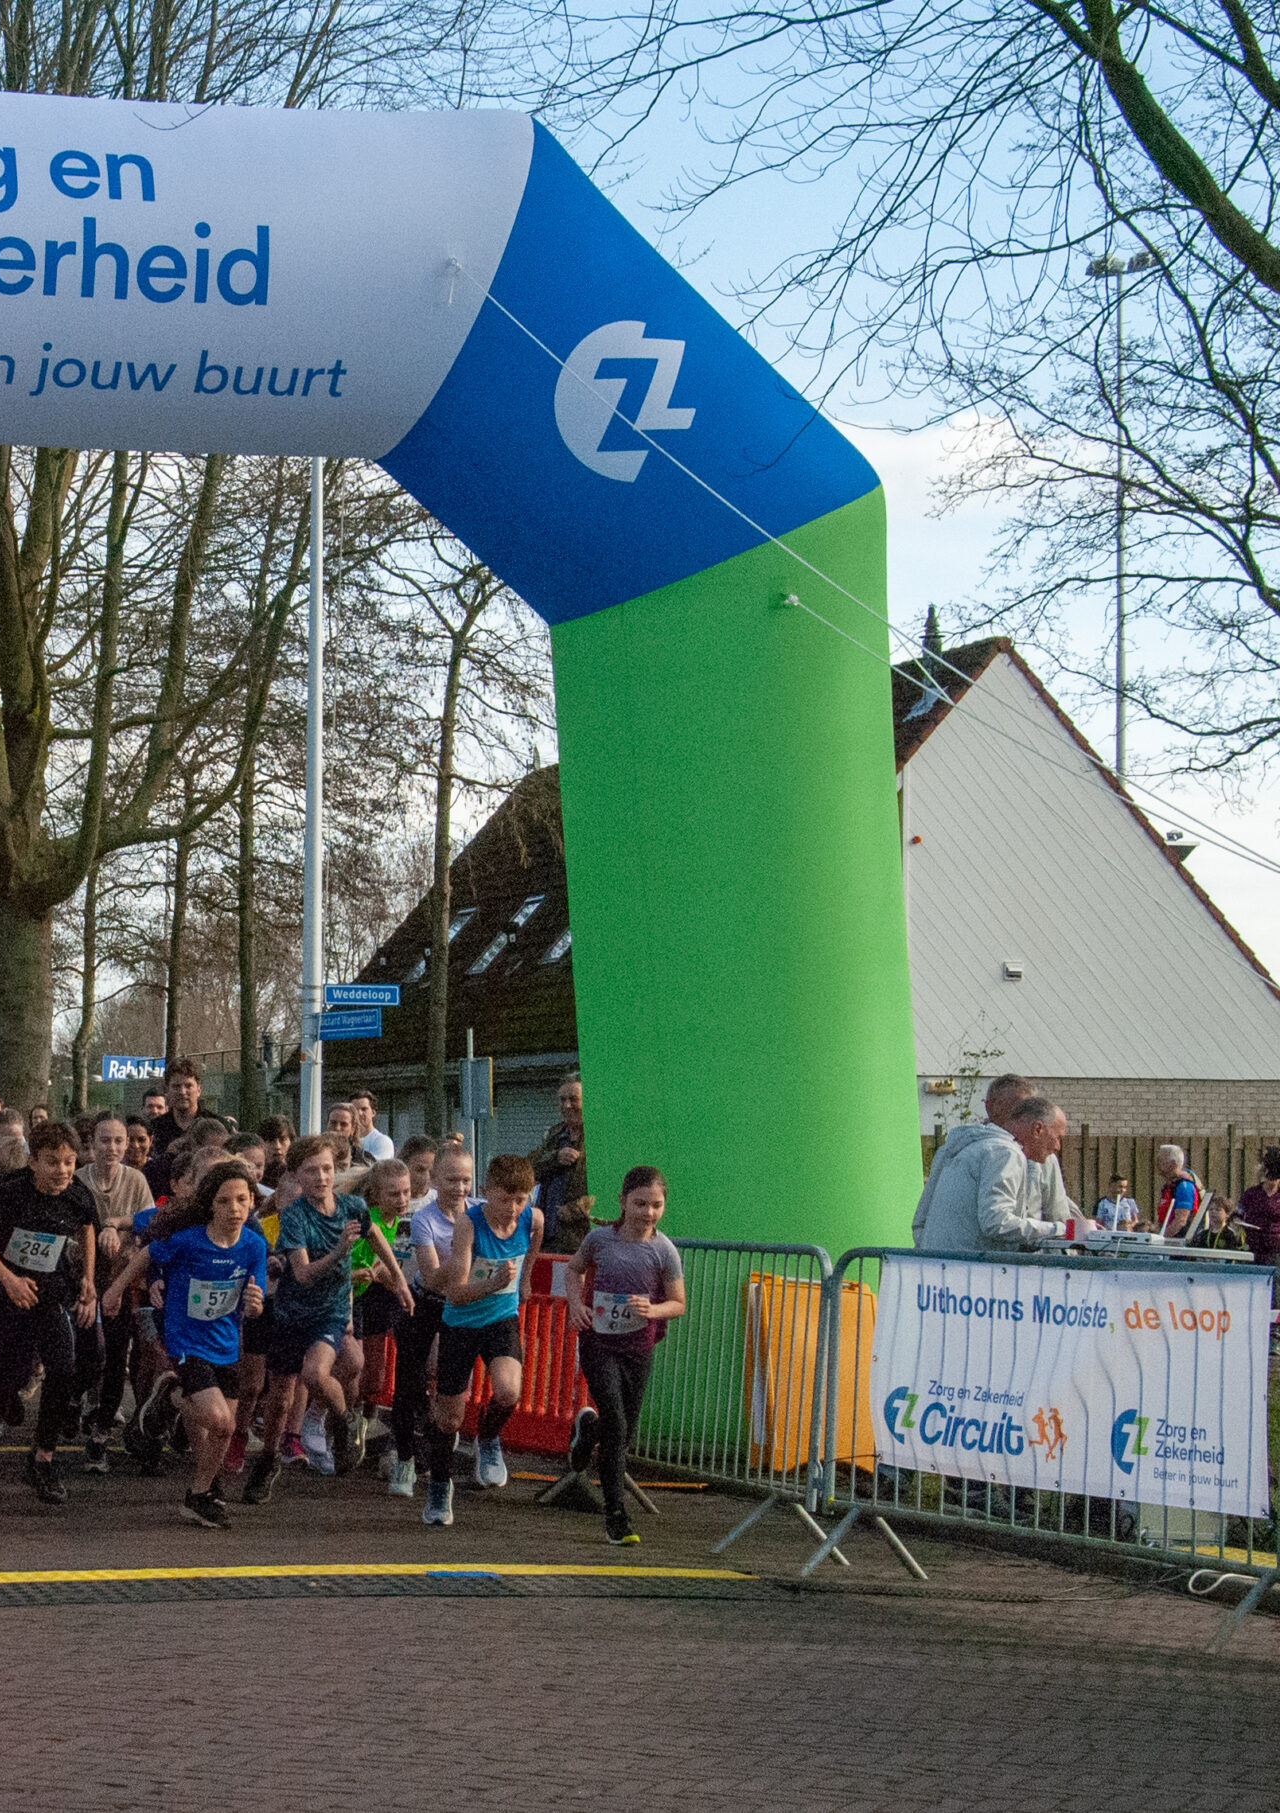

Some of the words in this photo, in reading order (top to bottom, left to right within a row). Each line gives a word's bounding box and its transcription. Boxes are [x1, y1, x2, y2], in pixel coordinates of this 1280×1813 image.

[49, 150, 155, 201] en
[29, 342, 177, 396] jouw
[194, 350, 347, 397] buurt
[332, 988, 392, 1002] Weddeloop
[20, 1241, 51, 1258] 284
[208, 1291, 228, 1306] 57
[611, 1304, 631, 1319] 64
[916, 1283, 1024, 1321] Uithoorns
[1032, 1294, 1116, 1334] Mooiste,
[1124, 1300, 1161, 1330] de
[1168, 1301, 1231, 1340] loop
[928, 1380, 955, 1400] Zorg
[957, 1387, 970, 1400] en
[973, 1386, 1025, 1407] Zekerheid
[919, 1401, 1024, 1456] Circuit
[1156, 1418, 1186, 1443] Zorg
[1190, 1427, 1207, 1441] en
[1155, 1440, 1224, 1465] Zekerheid
[1153, 1467, 1176, 1480] Beter
[1179, 1470, 1186, 1483] in
[1189, 1471, 1211, 1486] jouw
[1214, 1474, 1238, 1489] buurt
